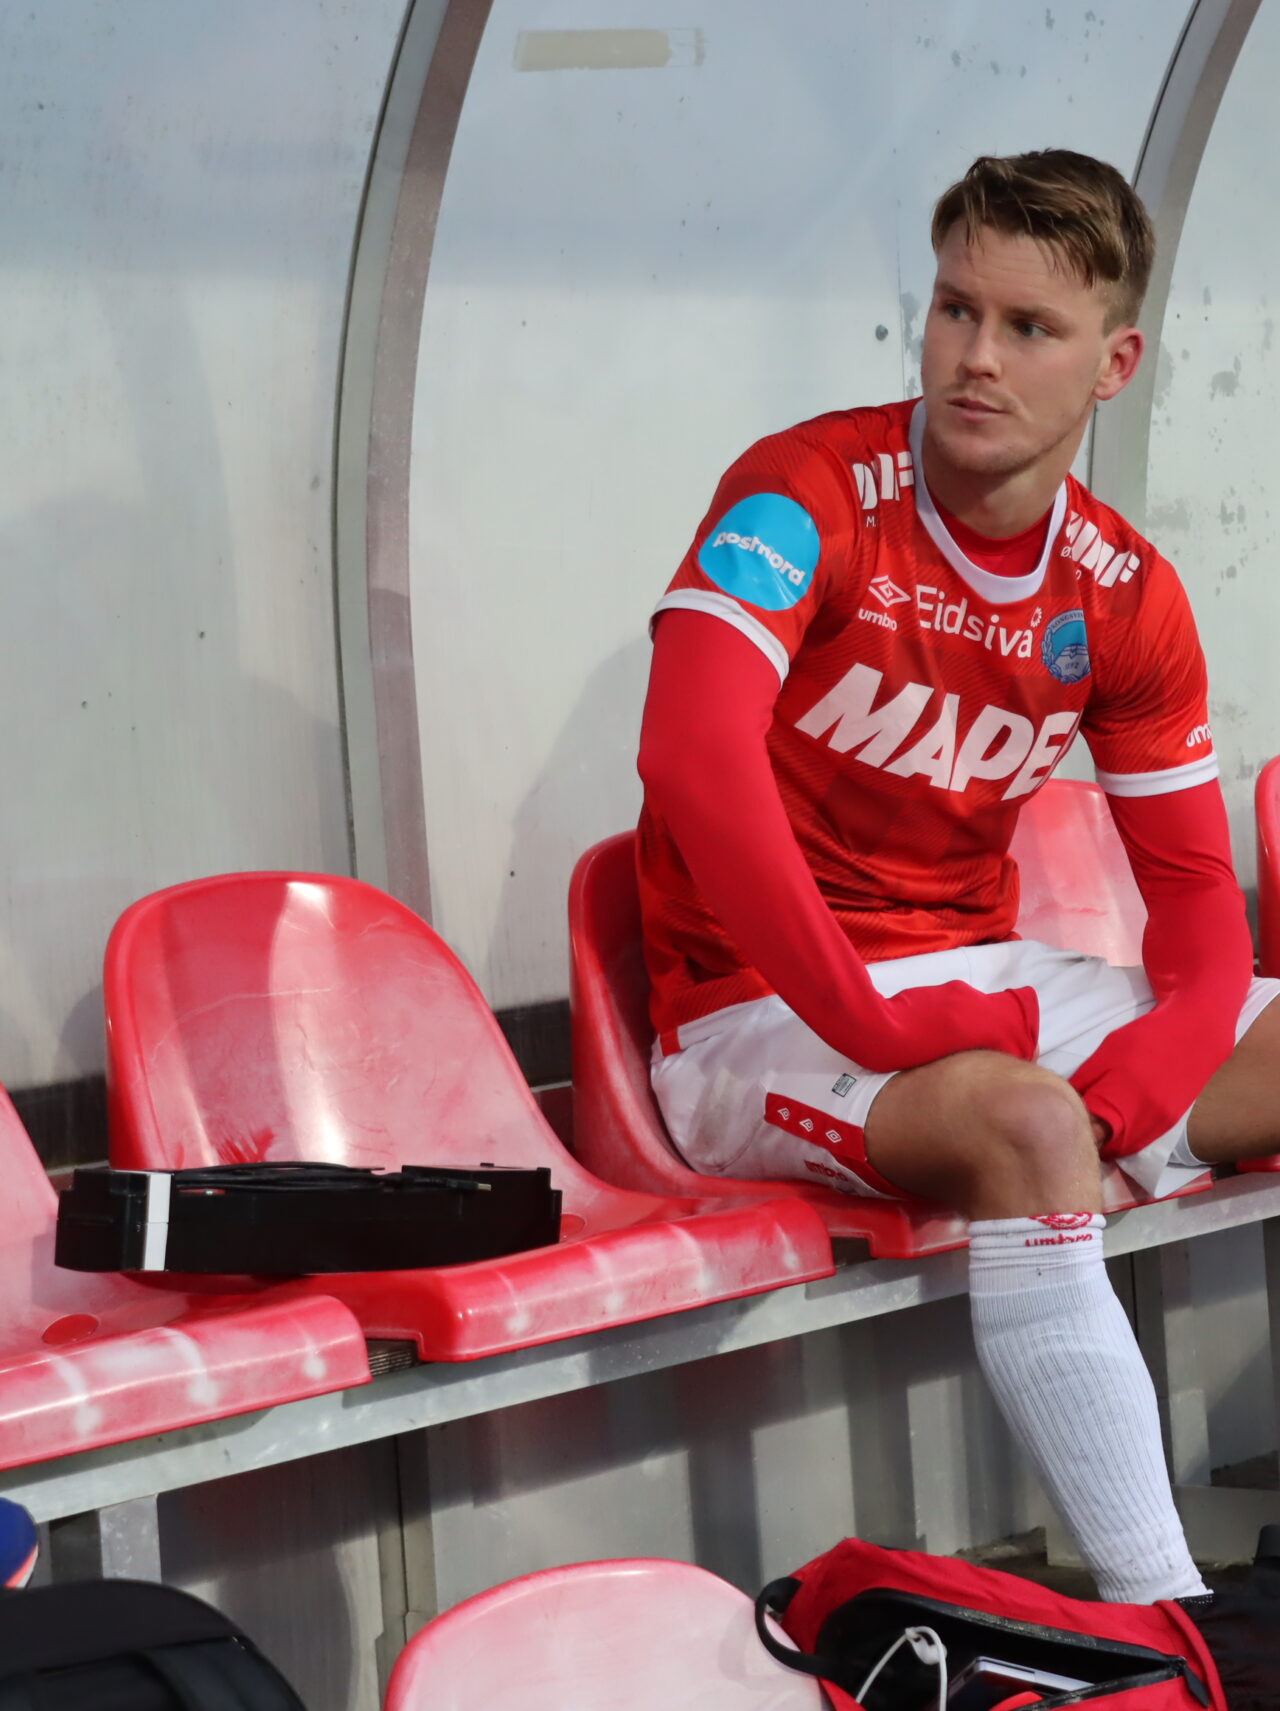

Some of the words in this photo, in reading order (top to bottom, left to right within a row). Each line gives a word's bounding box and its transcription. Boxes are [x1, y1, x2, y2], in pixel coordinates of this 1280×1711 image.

[712, 531, 806, 586] postnord
[857, 608, 898, 632] umbo
[916, 584, 1034, 658] Eidsiva
[793, 662, 1084, 801] MAPE
